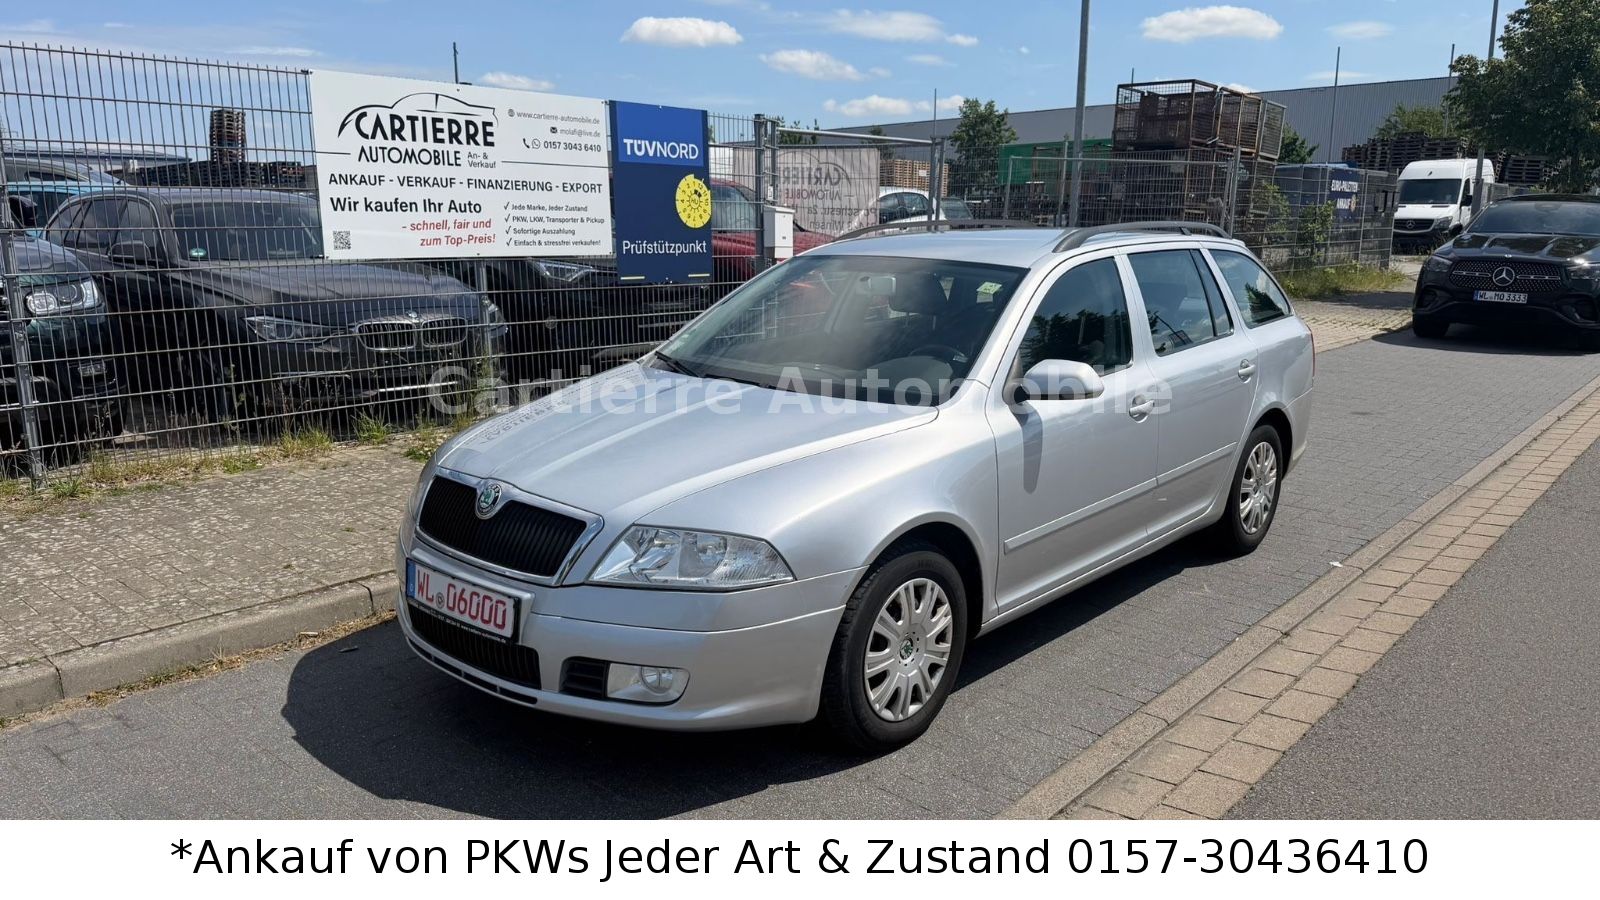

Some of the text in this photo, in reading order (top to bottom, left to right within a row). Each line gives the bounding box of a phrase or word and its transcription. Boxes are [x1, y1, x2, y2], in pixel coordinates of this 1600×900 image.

[355, 111, 495, 147] CARTIERRE
[543, 140, 601, 153] 0157 3043 6410
[358, 145, 462, 167] AUTOMOBILE
[467, 151, 481, 160] An-
[467, 160, 496, 169] Verkauf
[328, 173, 385, 186] ANKAUF
[397, 176, 456, 188] VERKAUF
[467, 178, 553, 191] FINANZIERUNG
[562, 182, 602, 193] EXPORT
[330, 197, 482, 213] Wir kaufen Ihr Auto
[526, 204, 547, 212] Marke,
[410, 219, 451, 231] schnell,
[453, 219, 471, 230] fair
[473, 218, 492, 229] und
[512, 215, 529, 223] PKW,
[530, 216, 545, 224] LKW,
[546, 216, 579, 224] Transporter
[586, 216, 605, 225] Pickup
[513, 227, 576, 236] Sofortige Auszahlung
[420, 233, 496, 247] zum Top-Preis!
[622, 240, 707, 256] Prüfstützpunkt
[1479, 292, 1488, 300] WL
[1506, 294, 1527, 303] 3333
[417, 570, 434, 602] WL
[446, 583, 506, 630] 06000
